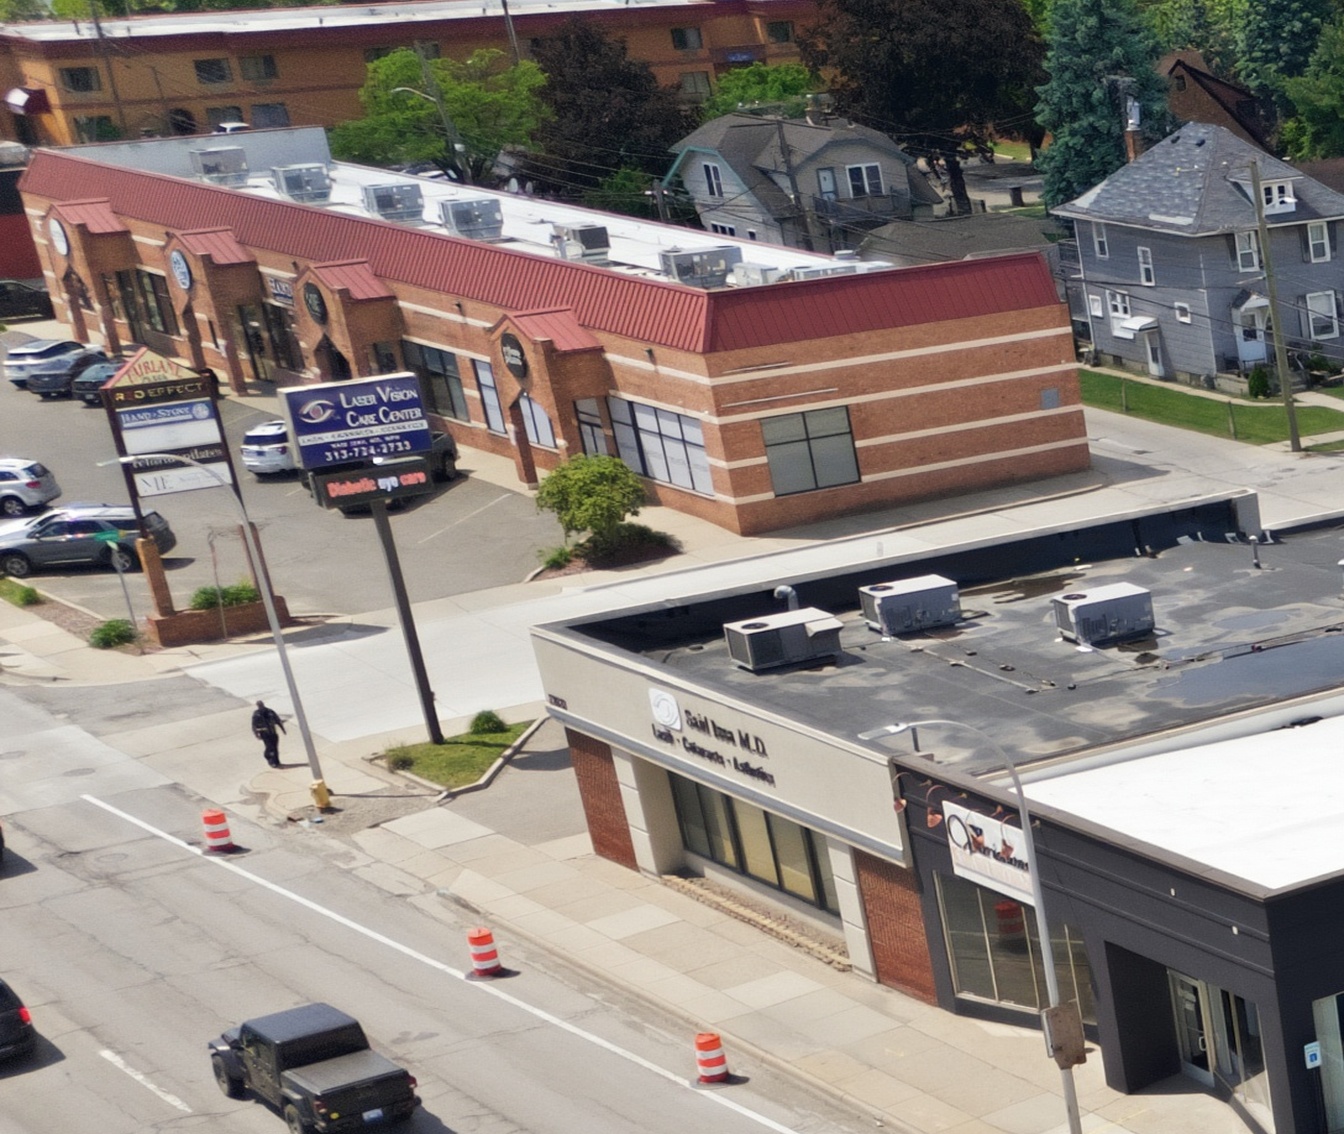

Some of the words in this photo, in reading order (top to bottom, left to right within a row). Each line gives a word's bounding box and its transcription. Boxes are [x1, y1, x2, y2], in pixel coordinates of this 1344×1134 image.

[148, 382, 203, 397] EFFECT
[340, 392, 377, 408] LASER
[376, 386, 418, 403] VISION
[121, 412, 152, 425] HAND
[346, 411, 378, 427] CARE
[379, 406, 422, 423] CENTER
[327, 477, 377, 497] Diabetic
[377, 476, 399, 492] eye
[400, 472, 426, 486] care
